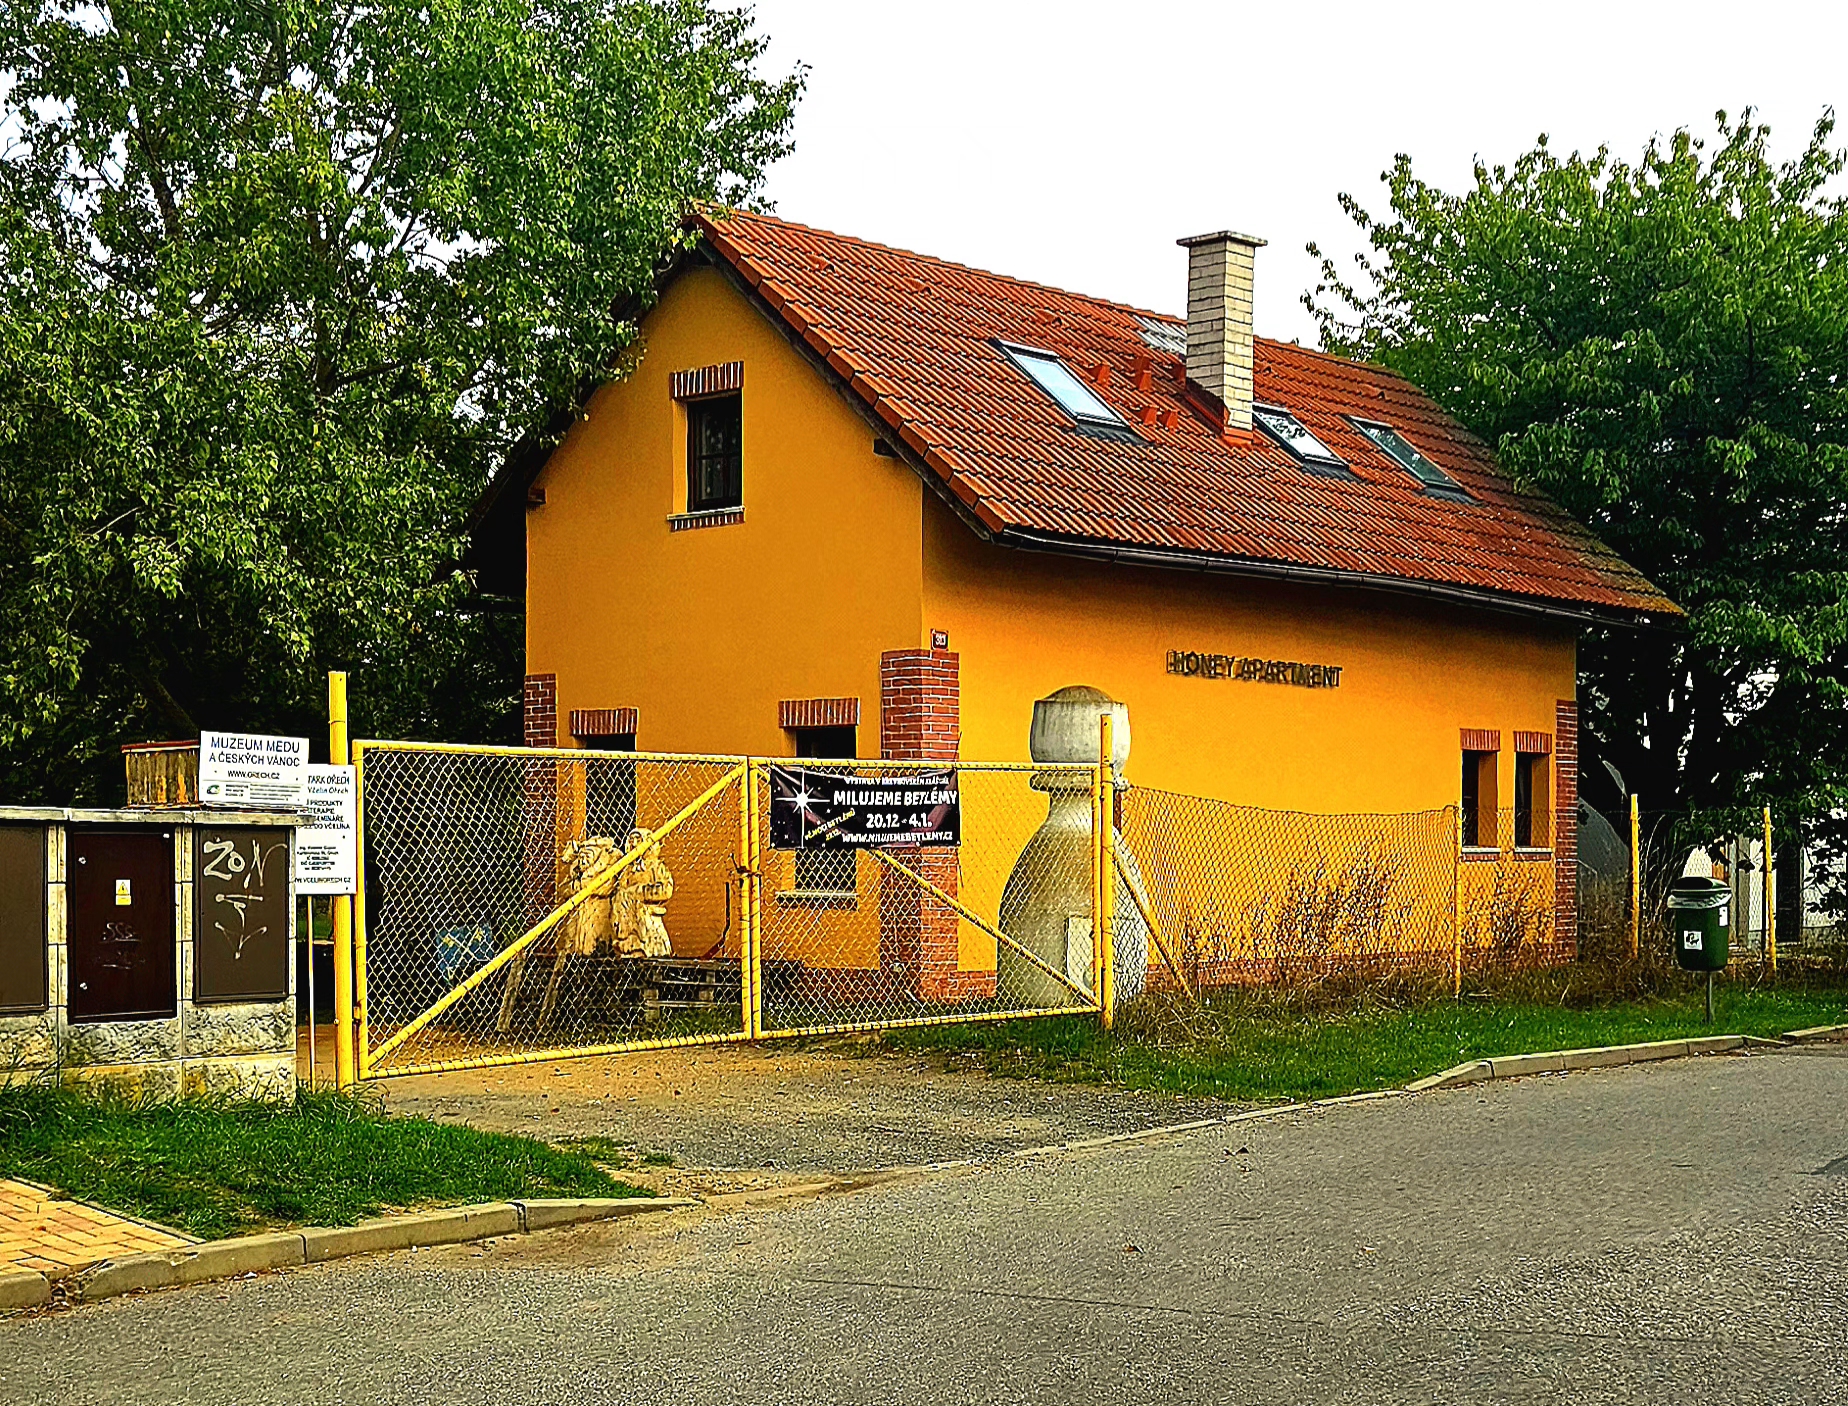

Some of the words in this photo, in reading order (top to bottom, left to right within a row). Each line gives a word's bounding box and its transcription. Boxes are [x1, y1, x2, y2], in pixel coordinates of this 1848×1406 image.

[1167, 650, 1235, 679] HONEY
[1237, 658, 1342, 688] APARTMENT
[210, 736, 263, 751] MUZEUM
[266, 740, 300, 753] MEDU
[209, 752, 216, 762] A
[218, 751, 264, 765] ČESKÝCH
[267, 755, 300, 767] VÁNOC
[833, 790, 902, 806] MILUJEME
[905, 787, 957, 805] BETLÉMY
[908, 813, 933, 829] 4.1.
